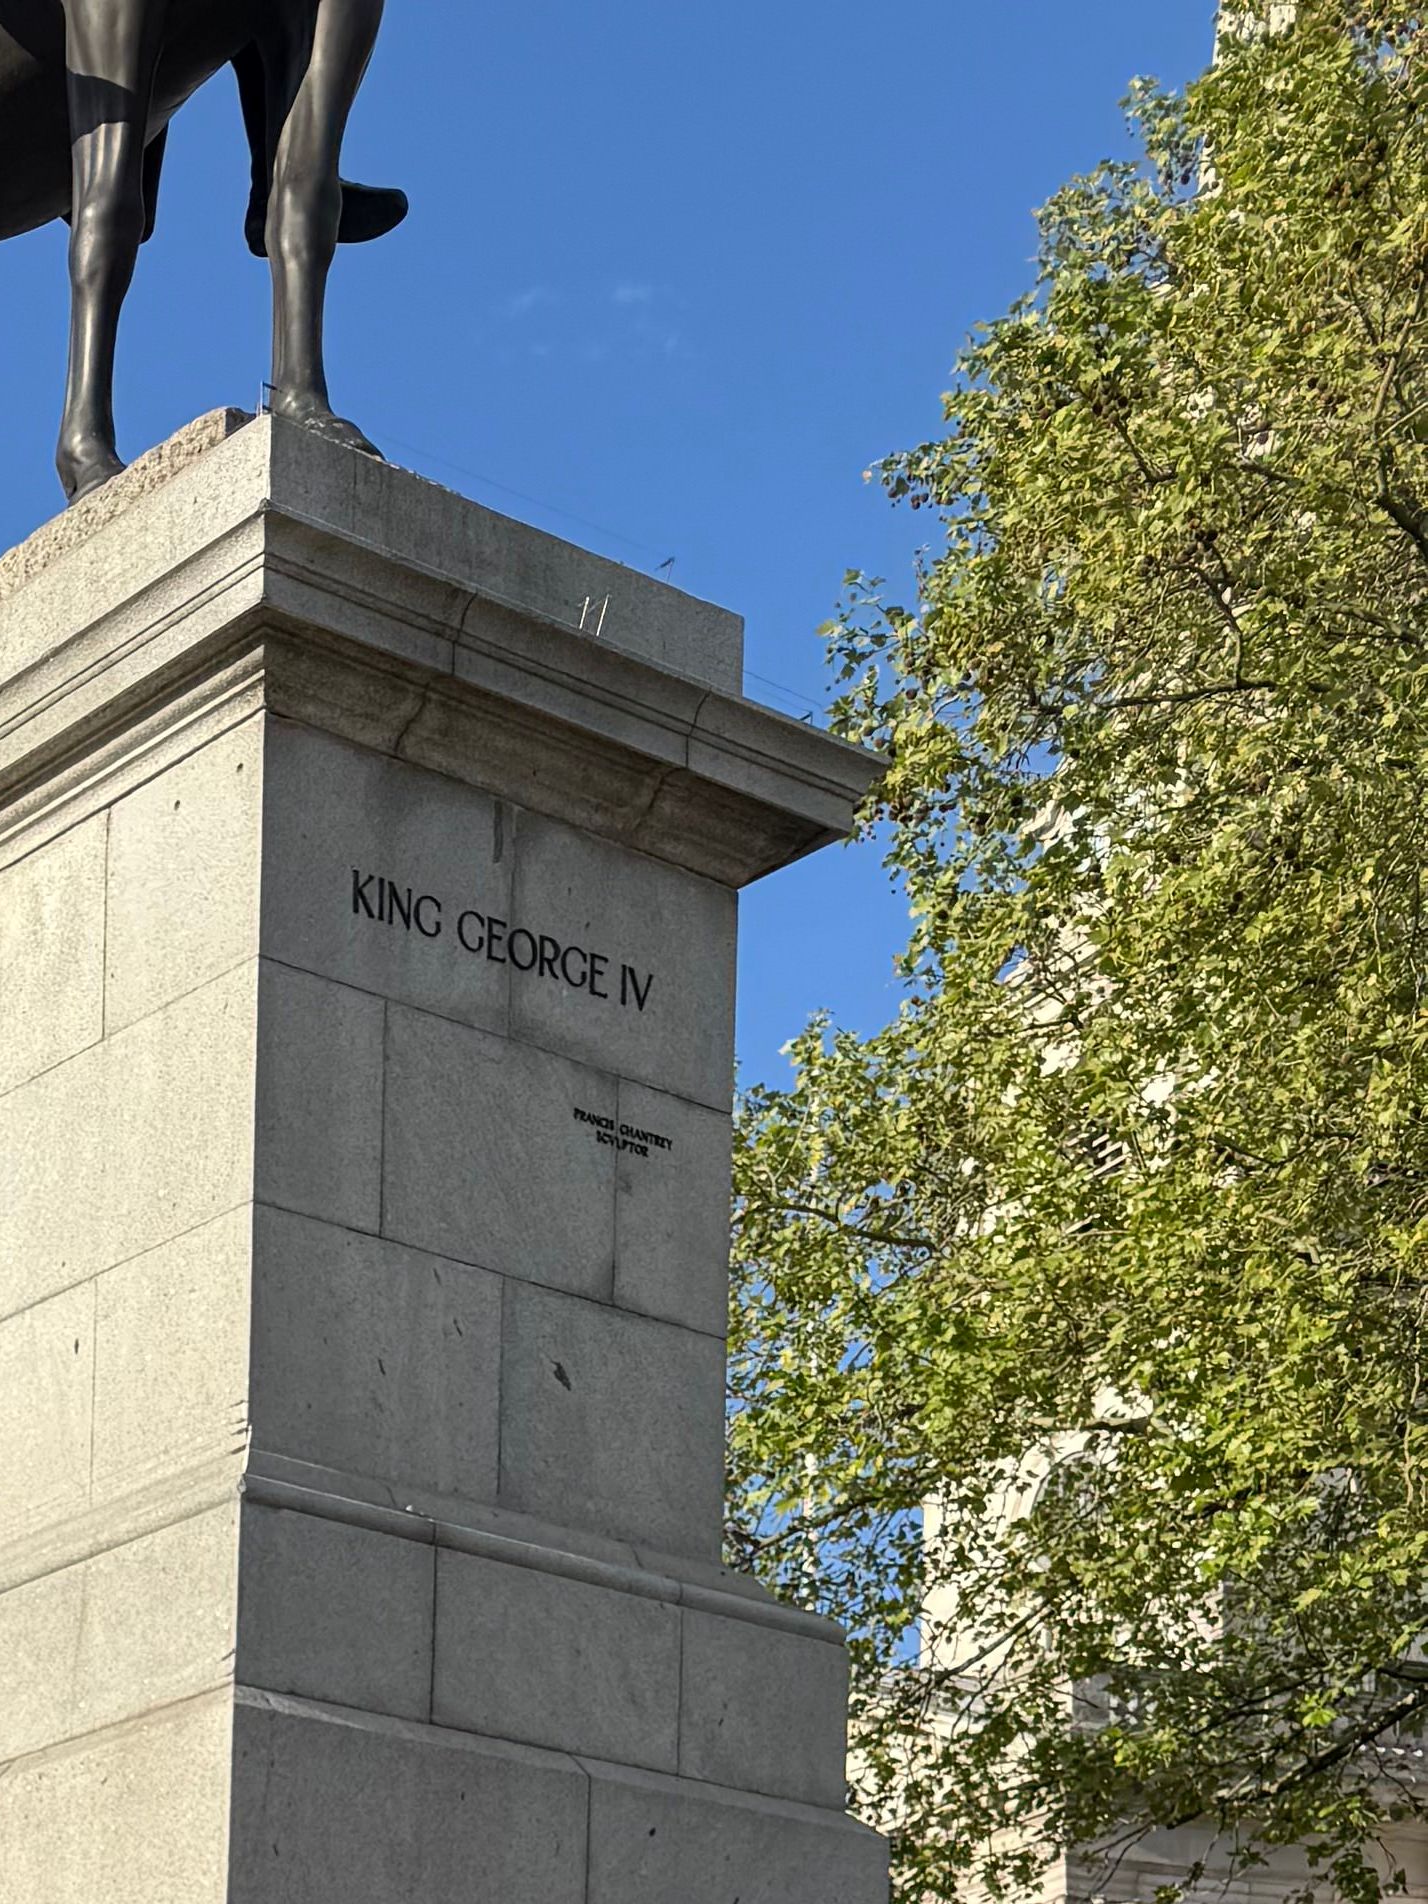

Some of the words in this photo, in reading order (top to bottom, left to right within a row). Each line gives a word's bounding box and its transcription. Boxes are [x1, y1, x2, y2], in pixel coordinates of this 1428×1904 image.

[351, 868, 442, 938] KING
[457, 910, 609, 1000] GEORGE
[619, 963, 655, 1012] IV
